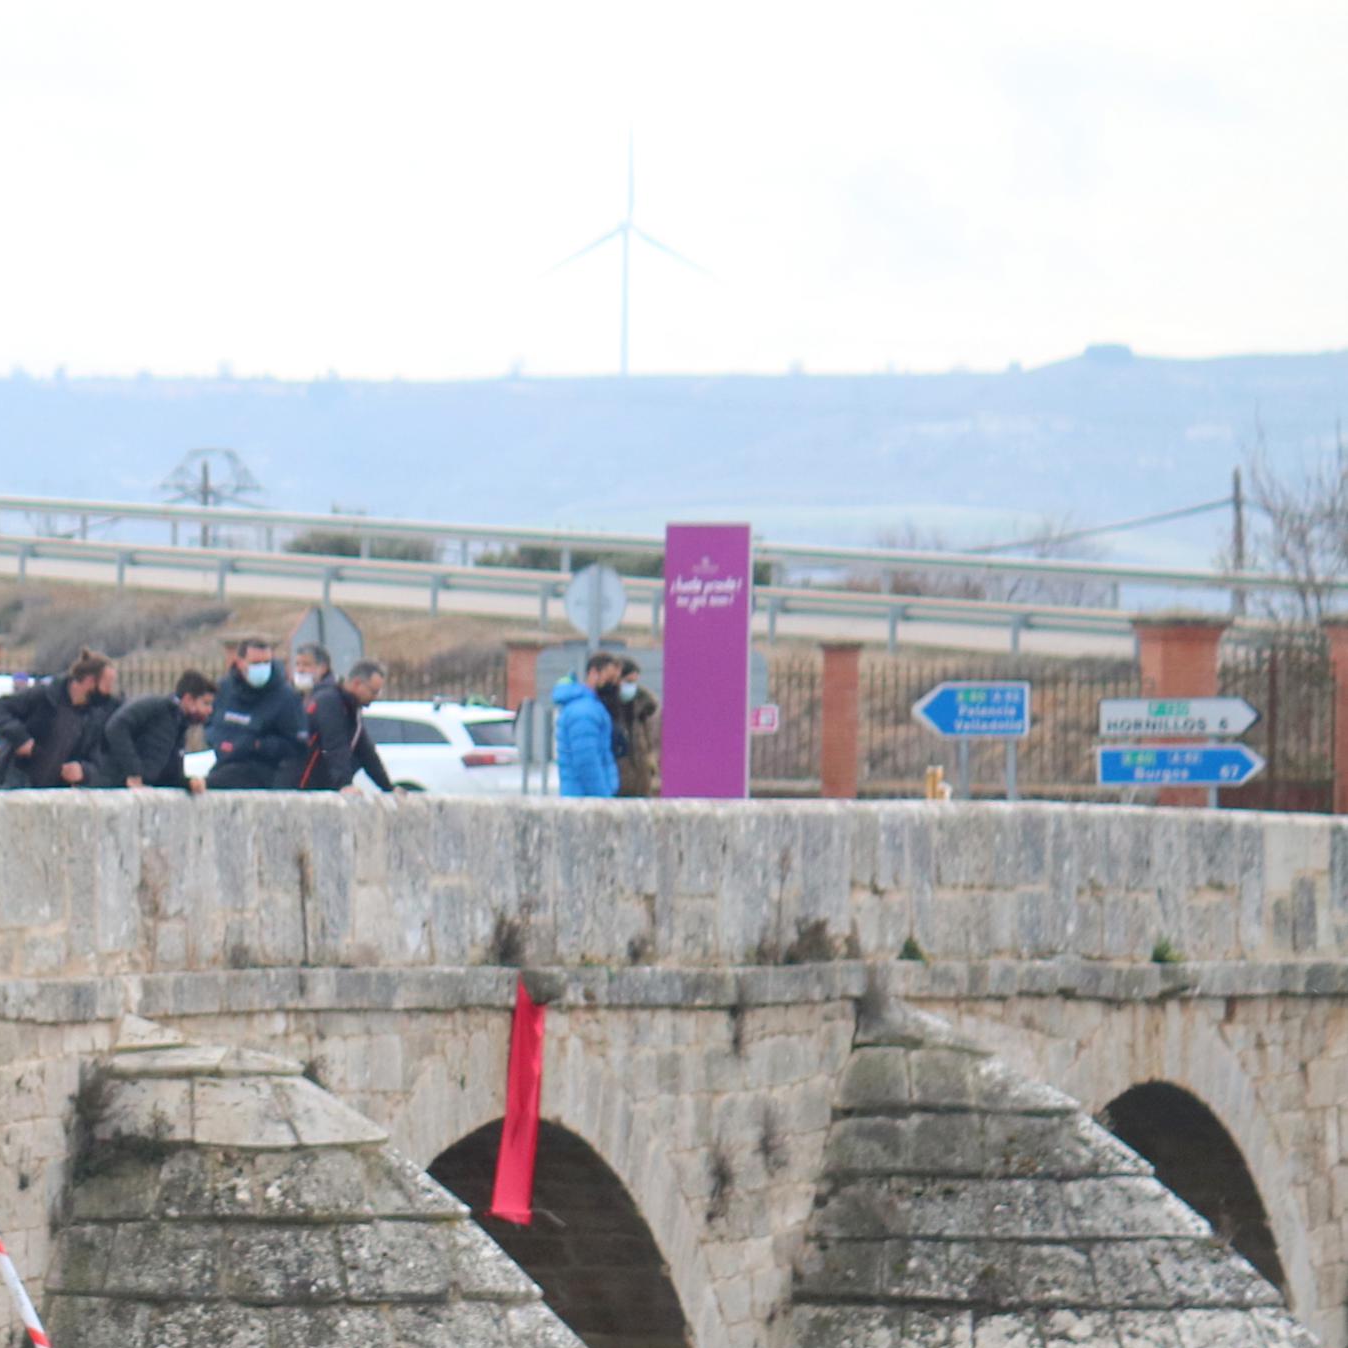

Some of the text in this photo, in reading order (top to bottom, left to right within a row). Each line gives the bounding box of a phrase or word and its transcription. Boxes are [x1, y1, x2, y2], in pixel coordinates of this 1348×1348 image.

[958, 704, 1016, 717] Palencia
[955, 719, 1023, 731] Valladolid
[1106, 718, 1208, 732] HORNILLOS
[1134, 765, 1241, 783] Burgos 67
